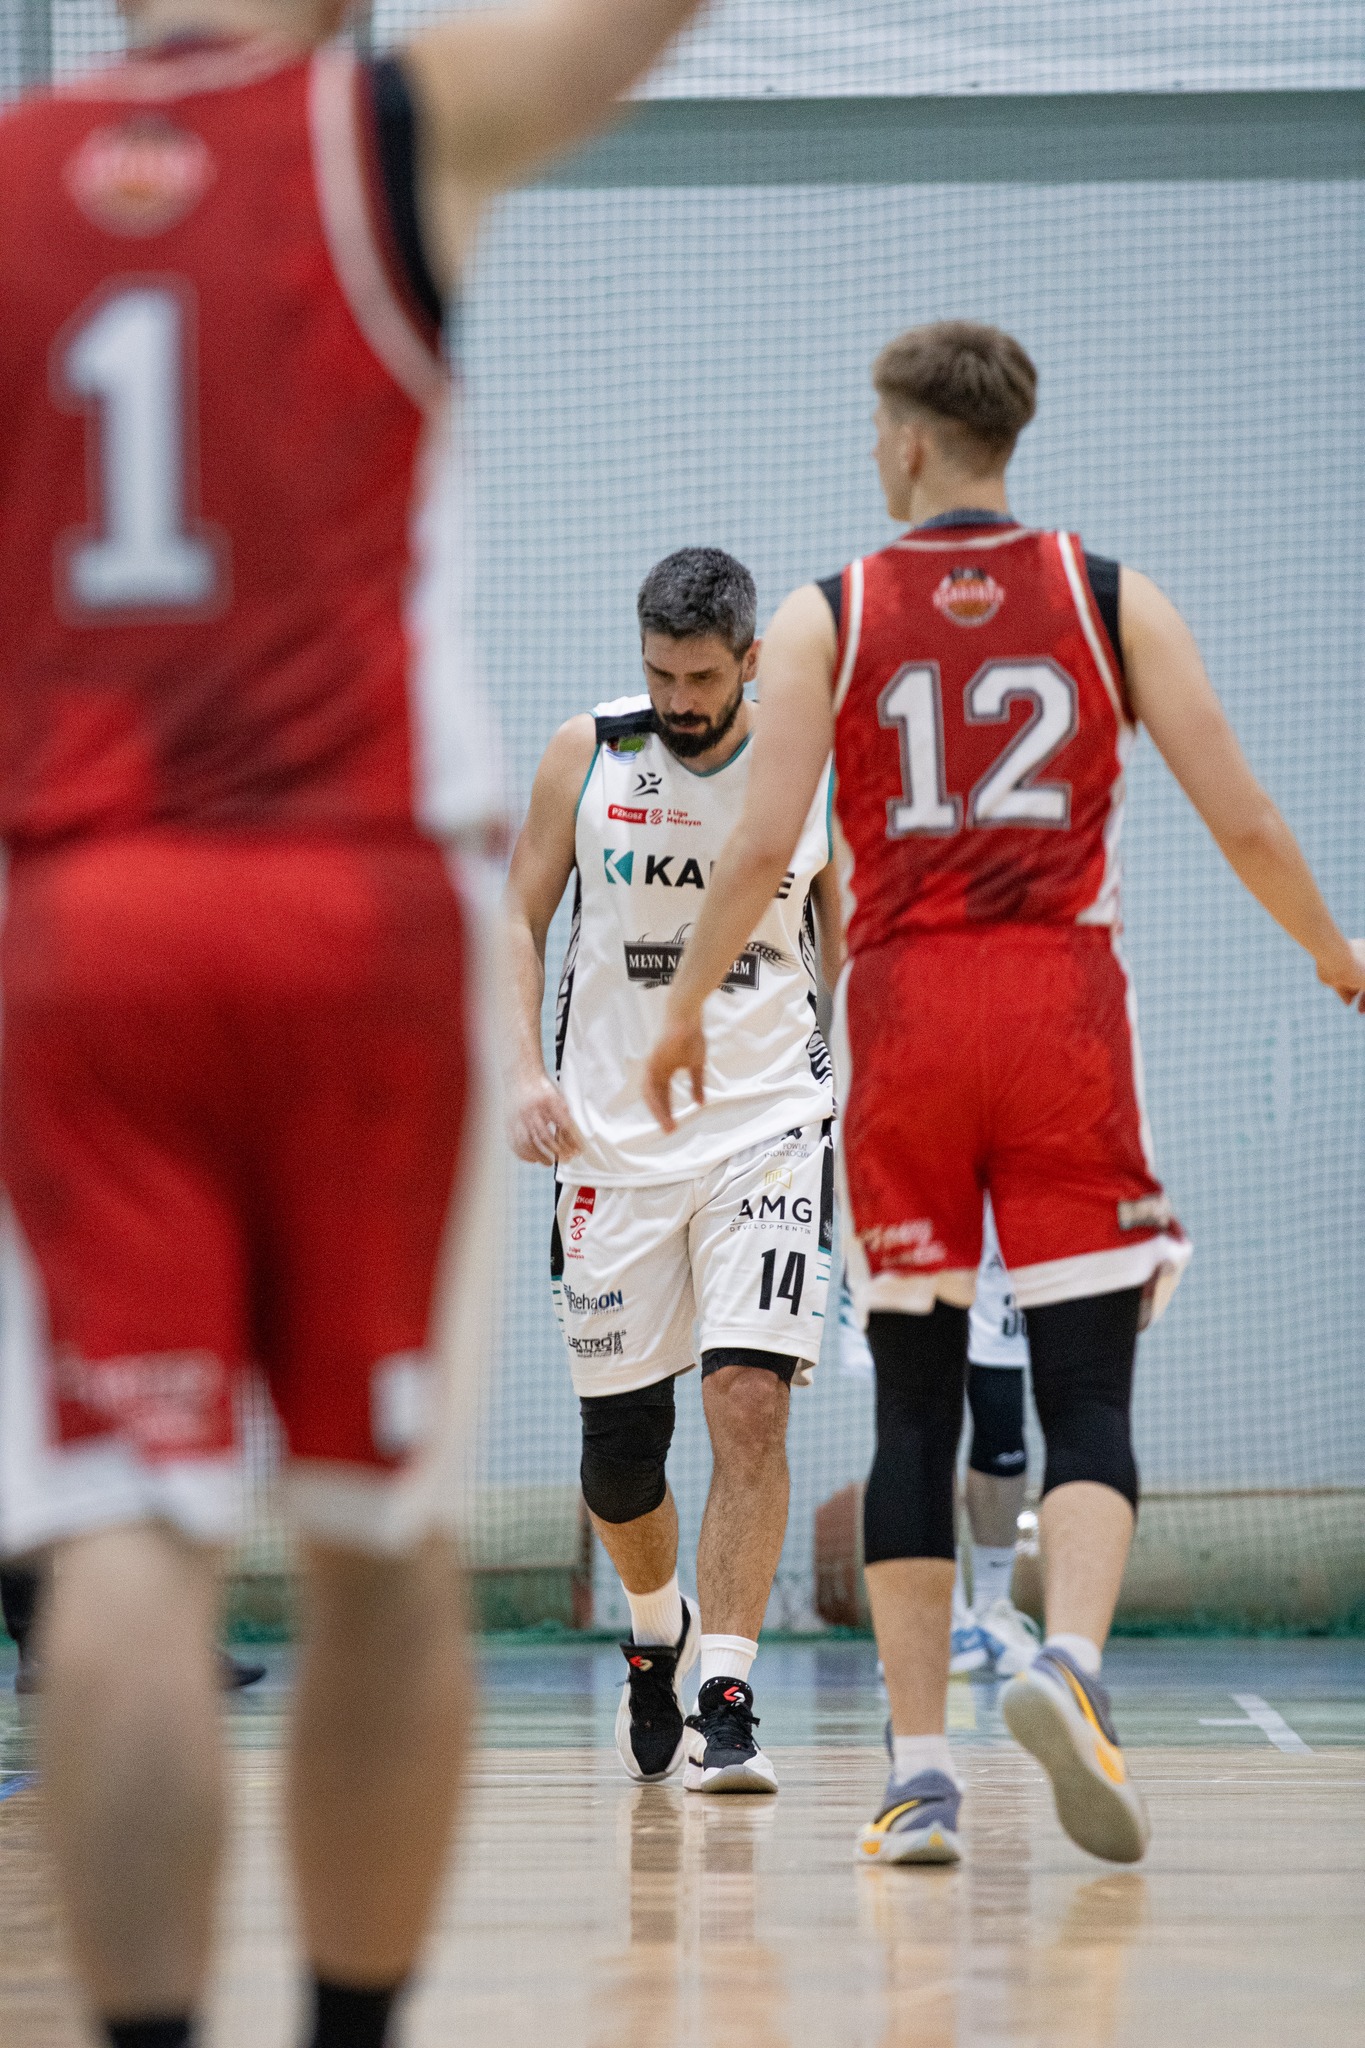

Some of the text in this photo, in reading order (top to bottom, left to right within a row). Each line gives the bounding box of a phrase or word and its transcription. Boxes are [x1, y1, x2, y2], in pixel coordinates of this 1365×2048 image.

[47, 270, 235, 627] 1
[877, 657, 1079, 839] 12
[628, 953, 664, 969] MŁYN
[732, 1195, 812, 1223] AMG
[570, 1289, 623, 1310] RehaON
[758, 1248, 806, 1316] 14
